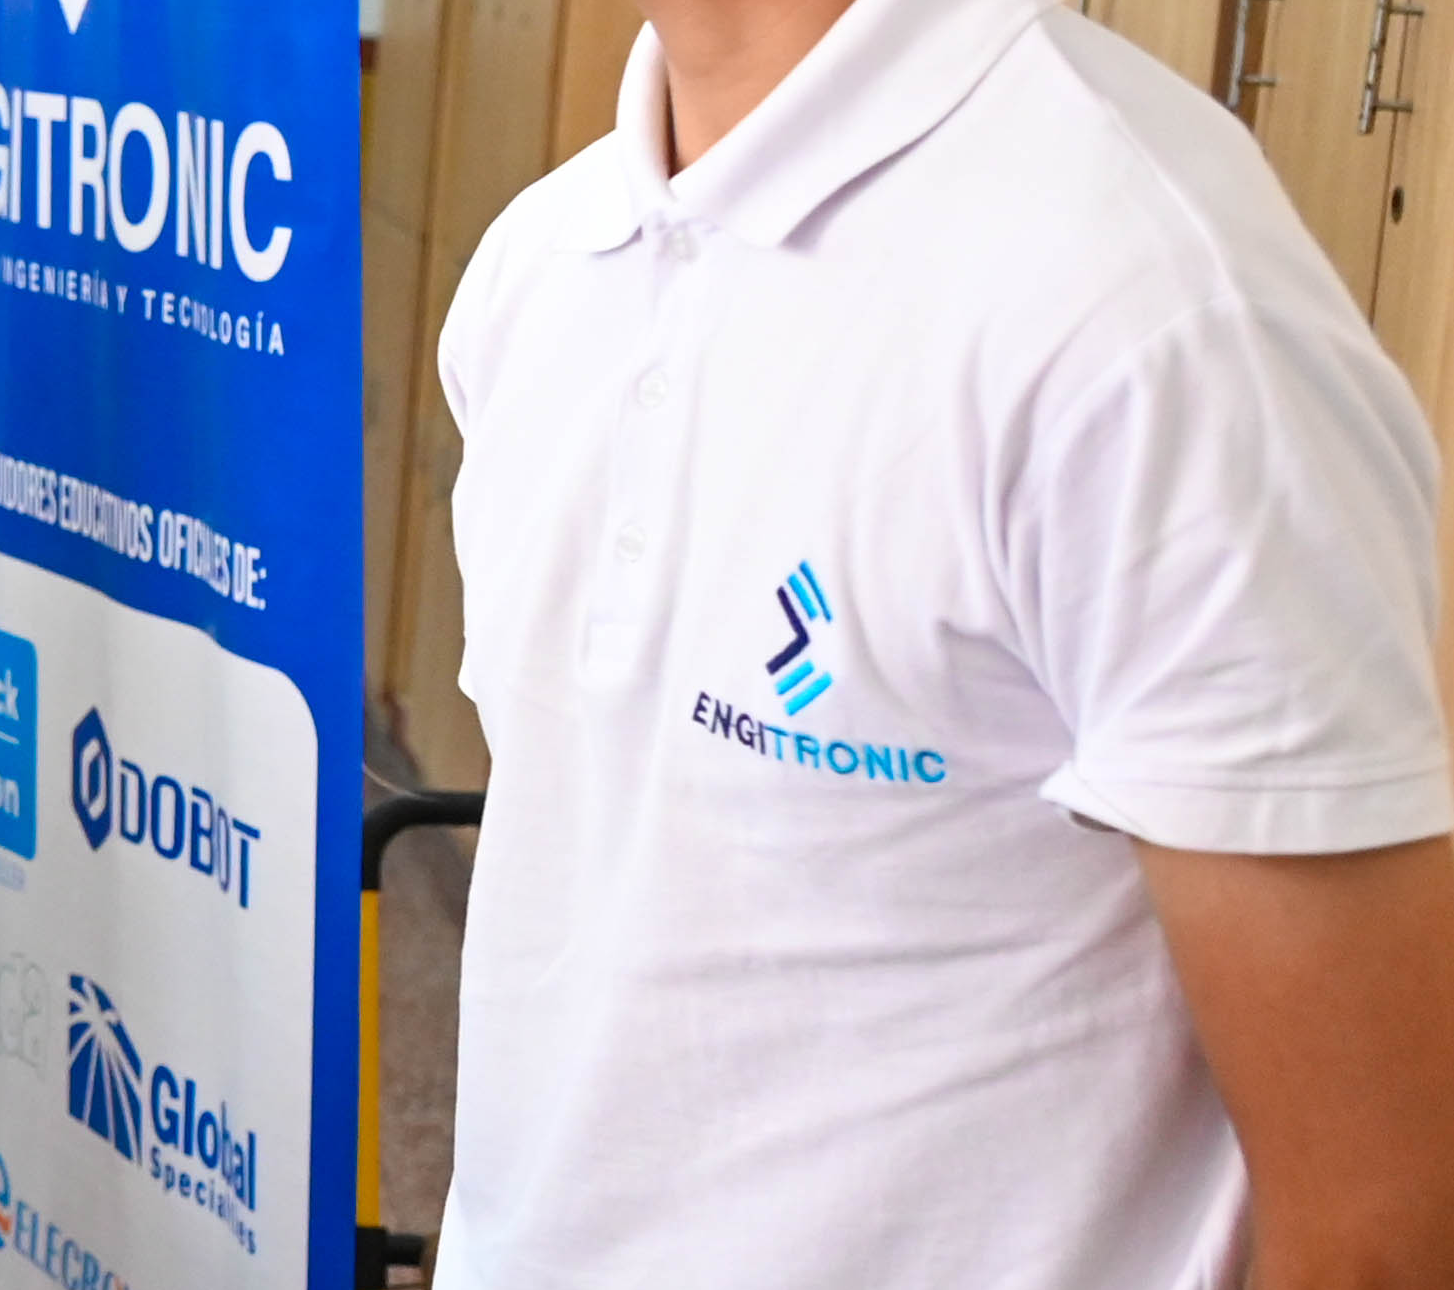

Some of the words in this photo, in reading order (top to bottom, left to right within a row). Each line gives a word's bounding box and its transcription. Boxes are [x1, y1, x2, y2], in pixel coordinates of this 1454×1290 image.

[115, 285, 128, 315] Y
[232, 541, 268, 611] DE:
[692, 691, 947, 784] ENGITRONIC
[120, 758, 262, 909] DOBOT
[150, 1065, 256, 1213] Global
